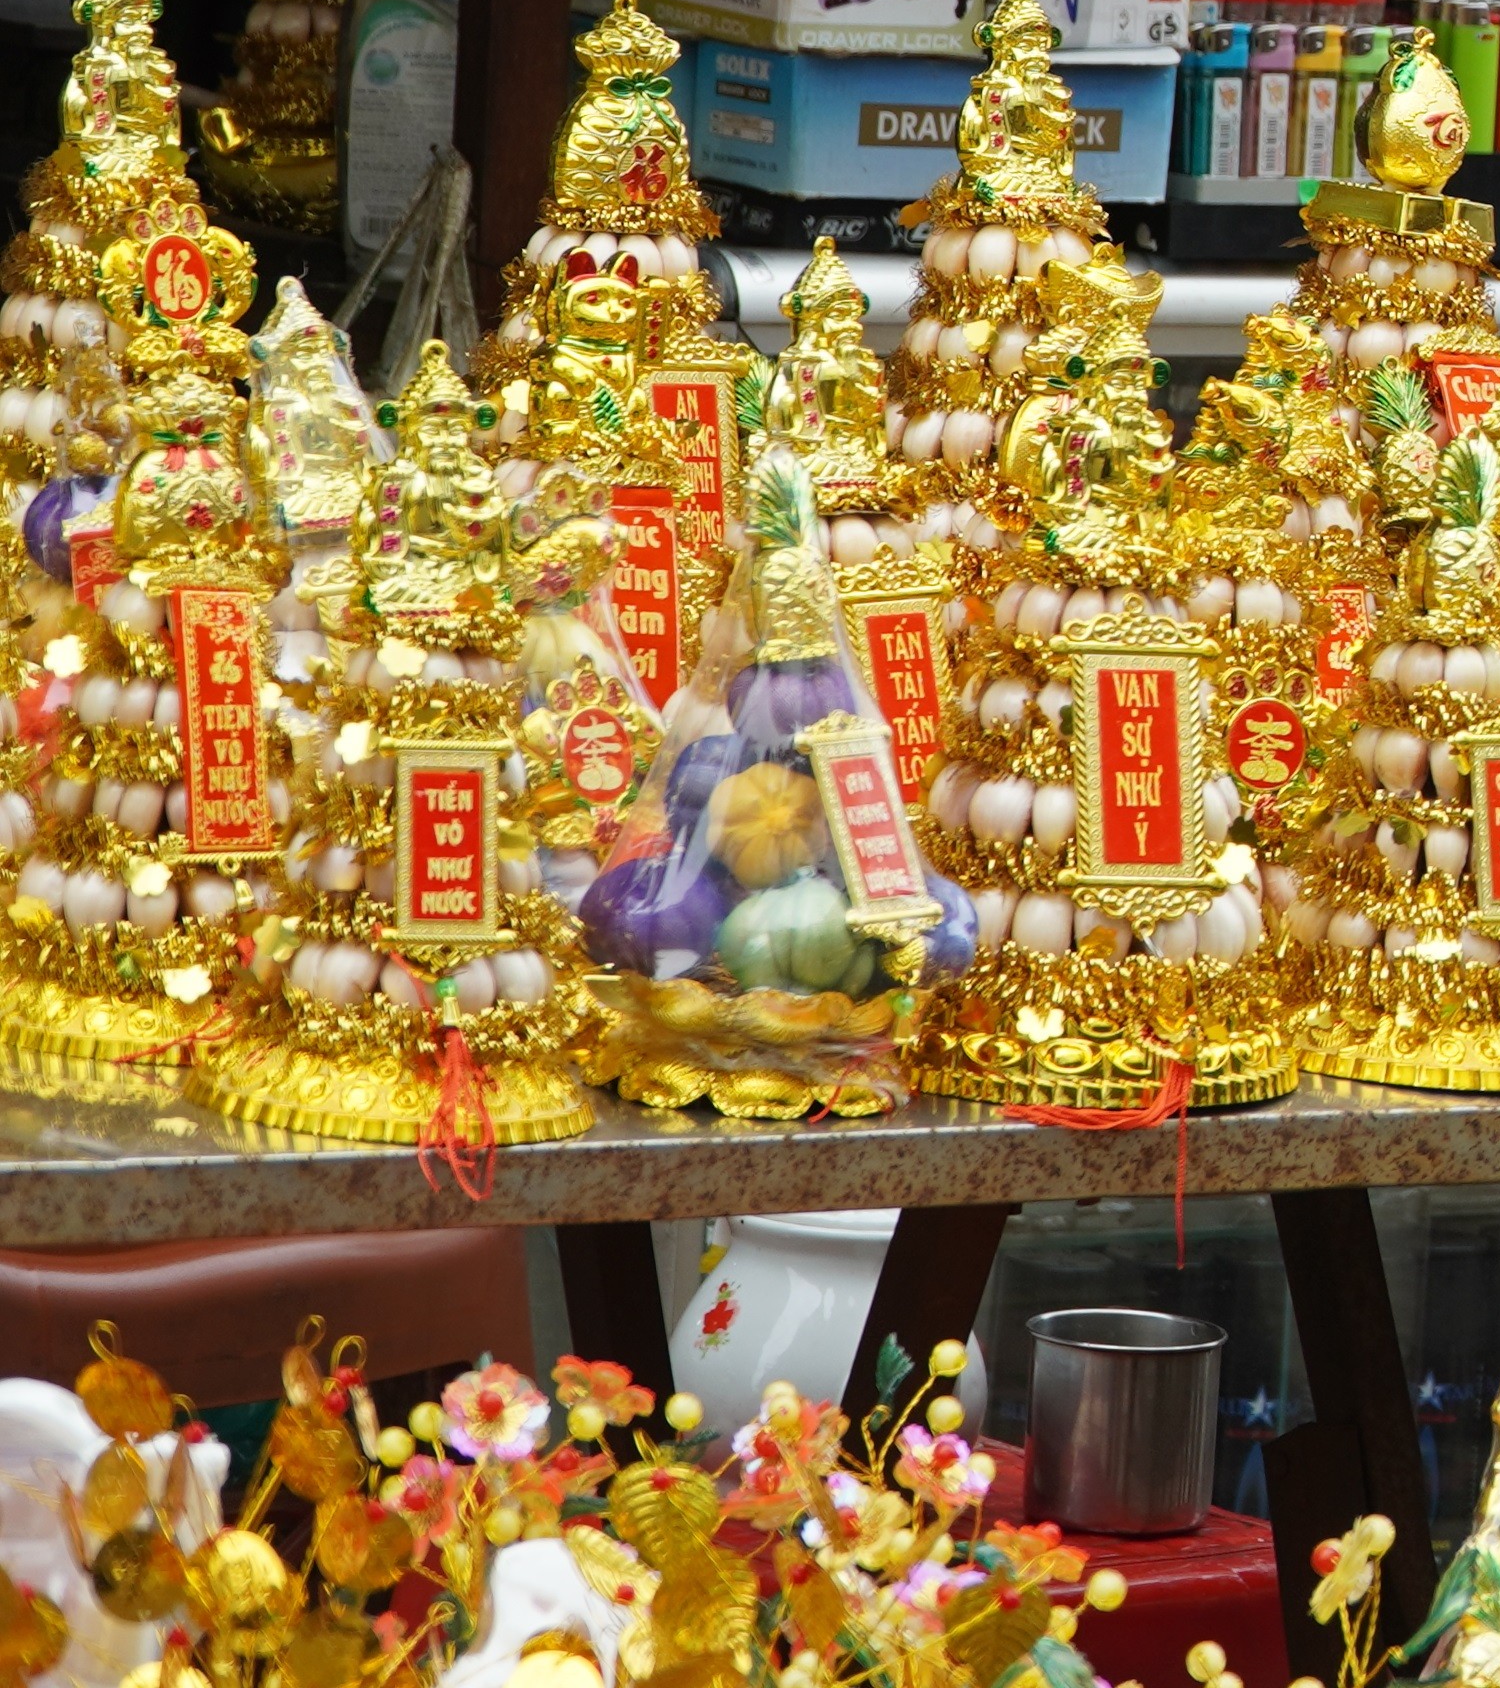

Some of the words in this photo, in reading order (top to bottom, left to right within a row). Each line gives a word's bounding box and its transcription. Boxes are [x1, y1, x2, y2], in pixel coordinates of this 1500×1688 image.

[800, 28, 898, 50] DRAWER
[902, 31, 964, 51] LOCK
[715, 52, 771, 82] SOLEX
[876, 109, 959, 143] DRAW
[1076, 115, 1106, 146] CK
[819, 219, 864, 238] BIC
[675, 390, 699, 418] AN
[1451, 373, 1500, 404] Chú
[615, 562, 669, 598] ừng
[881, 613, 923, 660] TẤN
[888, 664, 926, 701] TÀI
[1113, 673, 1159, 720] VẠN
[203, 694, 252, 731] TIỀN
[893, 704, 935, 750] TẤN
[212, 735, 241, 766] VÔ
[1121, 719, 1153, 768] SỰ
[208, 764, 255, 795] NHƯ
[1115, 768, 1161, 808] NHƯ
[203, 795, 258, 827] NƯỚC
[425, 783, 473, 812] TIỀN
[434, 817, 464, 846] VÔ
[1133, 817, 1148, 857] Ý
[426, 850, 471, 881] NHƯ
[419, 885, 476, 916] NƯỚC
